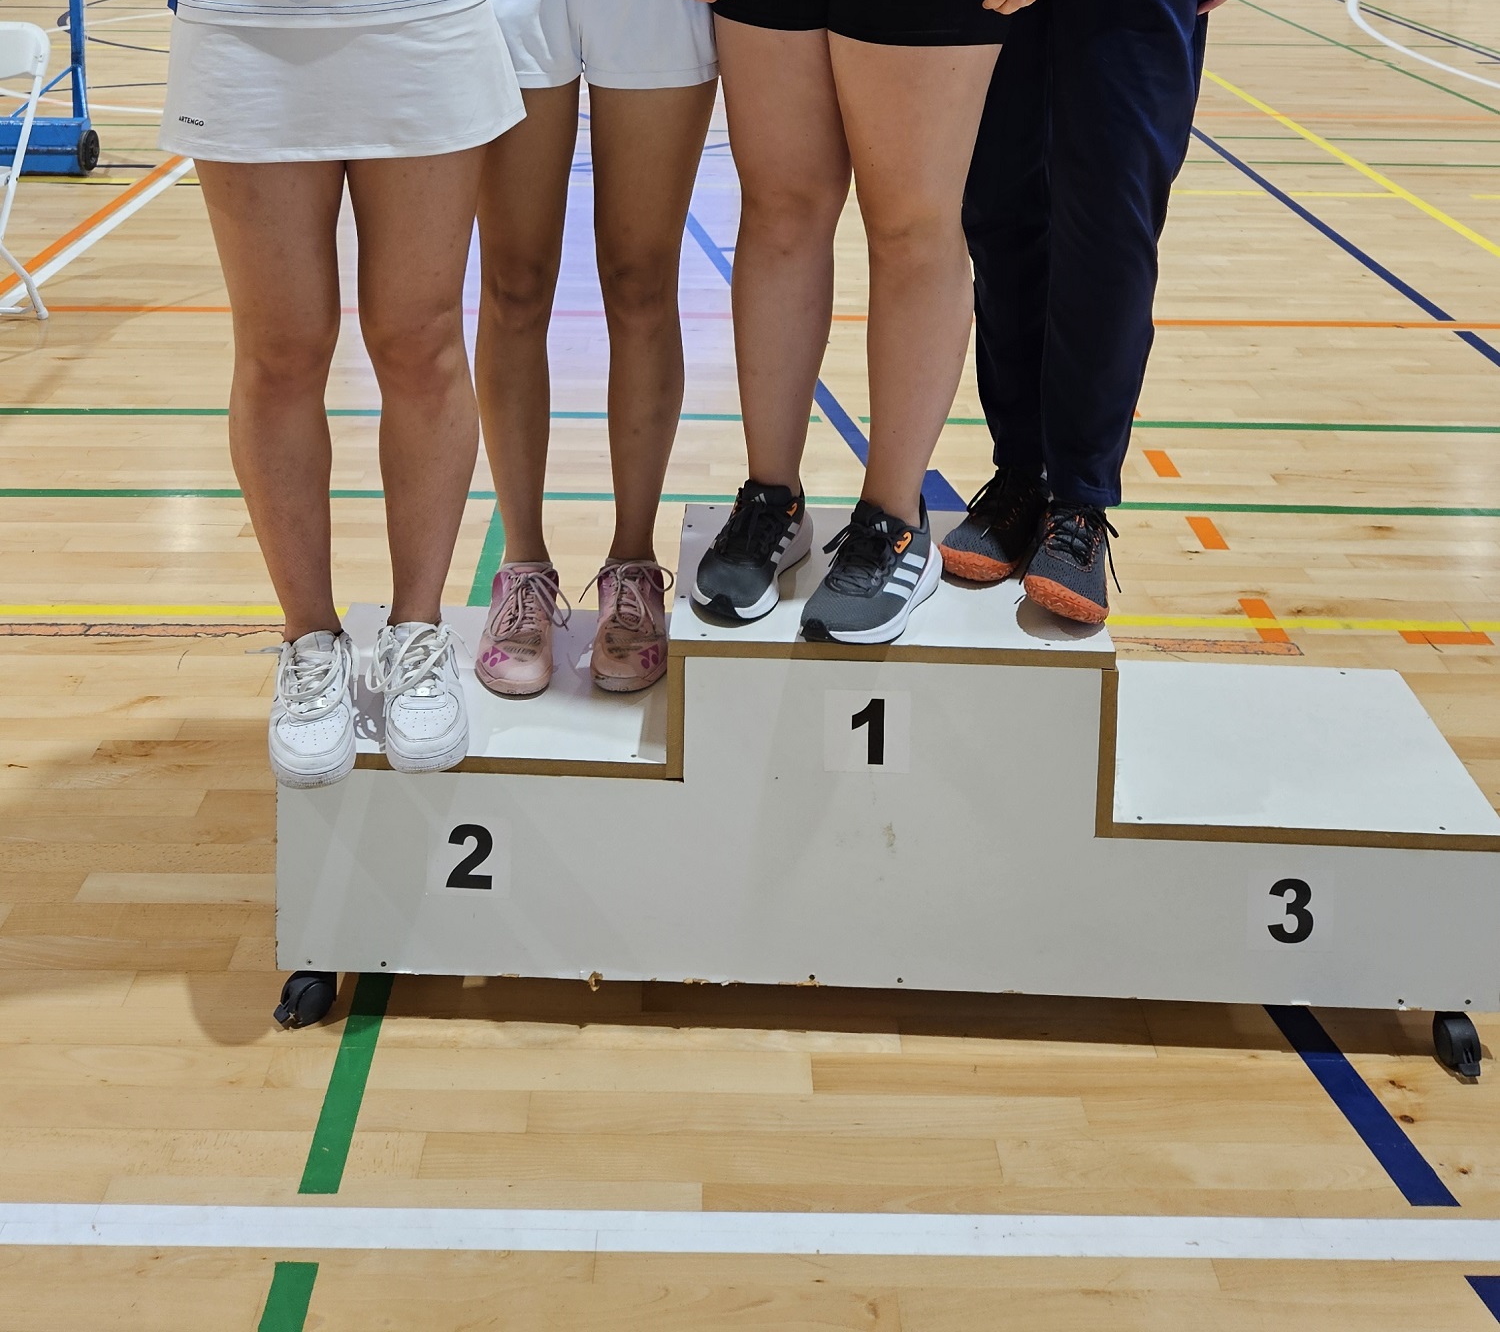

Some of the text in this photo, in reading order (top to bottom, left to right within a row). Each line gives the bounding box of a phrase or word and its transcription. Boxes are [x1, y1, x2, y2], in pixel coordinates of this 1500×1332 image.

[178, 115, 205, 127] ARTENGO
[852, 699, 885, 765] 1
[446, 824, 493, 889] 2
[1268, 879, 1314, 943] 3
